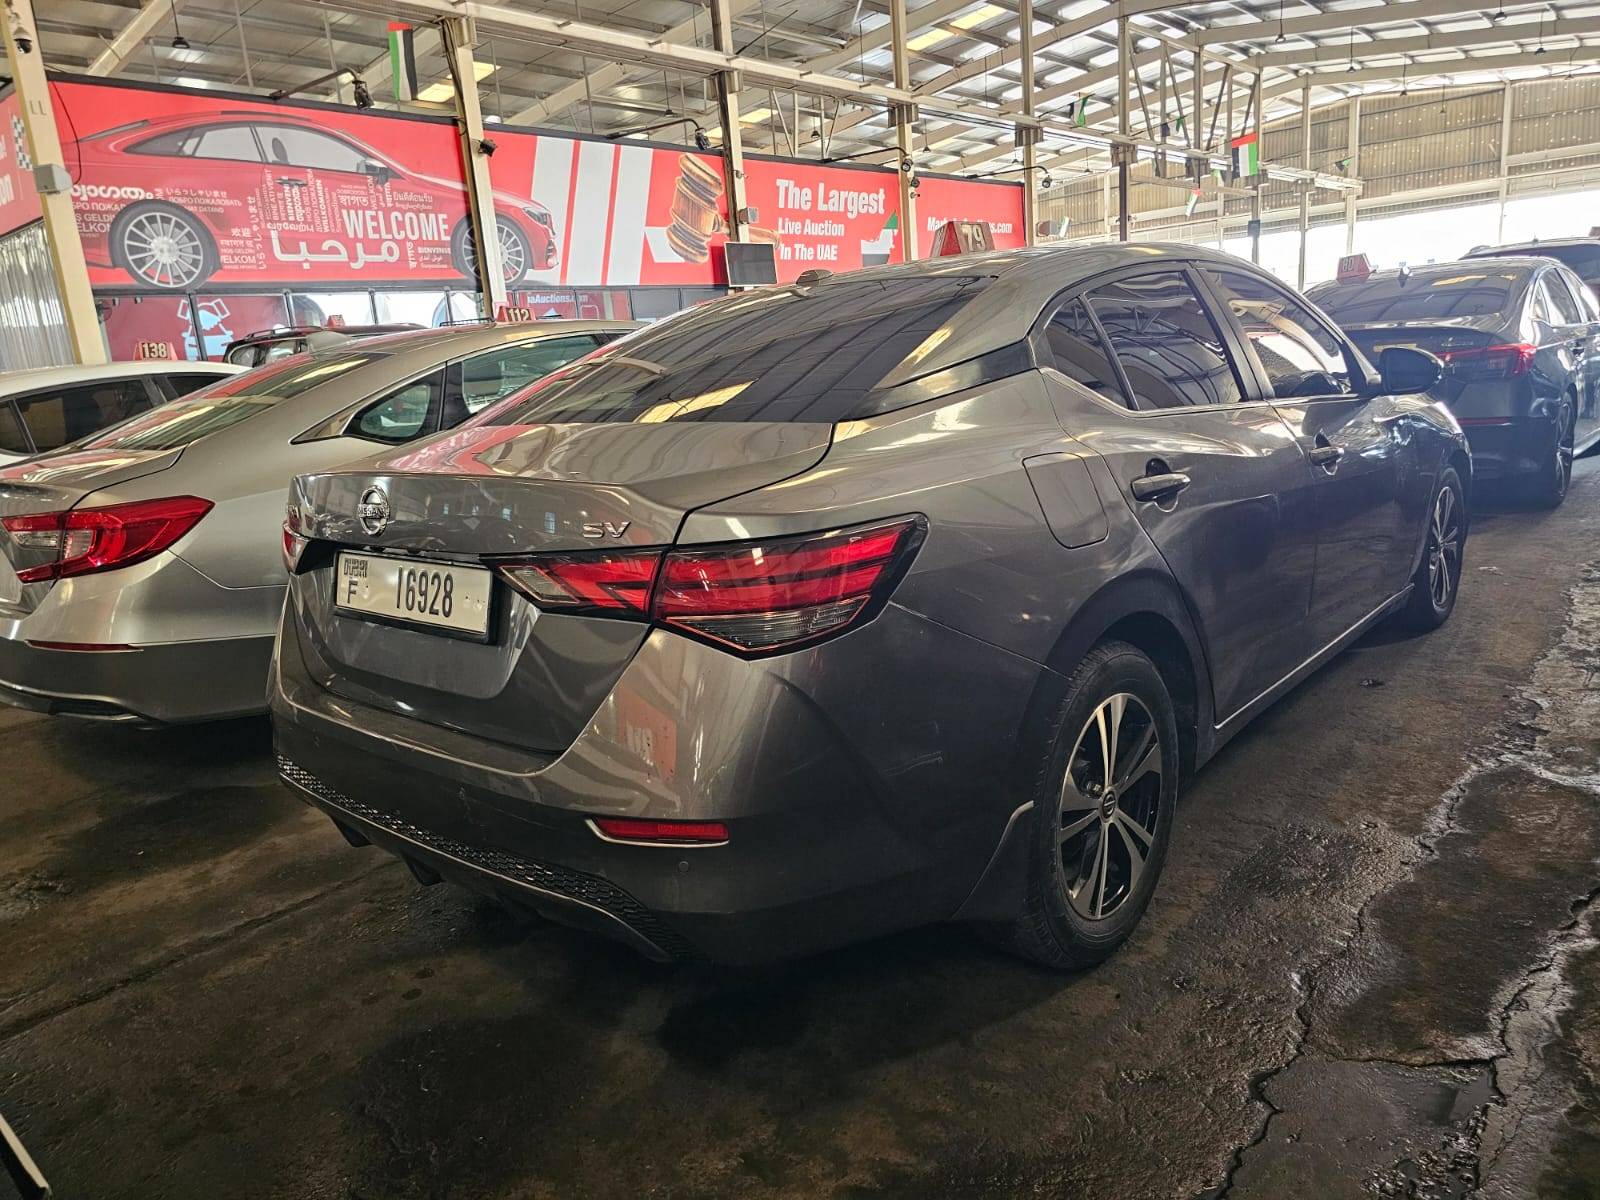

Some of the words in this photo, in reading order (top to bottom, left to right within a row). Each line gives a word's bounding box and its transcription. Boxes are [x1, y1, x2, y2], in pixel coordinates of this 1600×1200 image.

[316, 179, 330, 233] WILLKOMMEN
[776, 178, 812, 211] The
[817, 182, 886, 219] Largest
[342, 209, 451, 241] WELCOME
[777, 217, 802, 235] Live
[803, 218, 845, 237] Auction
[960, 223, 986, 252] 79
[270, 229, 400, 270] مرحبا
[780, 244, 791, 261] In
[794, 244, 816, 261] The
[816, 244, 838, 261] UAE
[508, 308, 529, 321] 112
[143, 342, 168, 358] 138
[583, 521, 632, 539] SV
[347, 580, 359, 604] F
[396, 565, 455, 619] 16928
